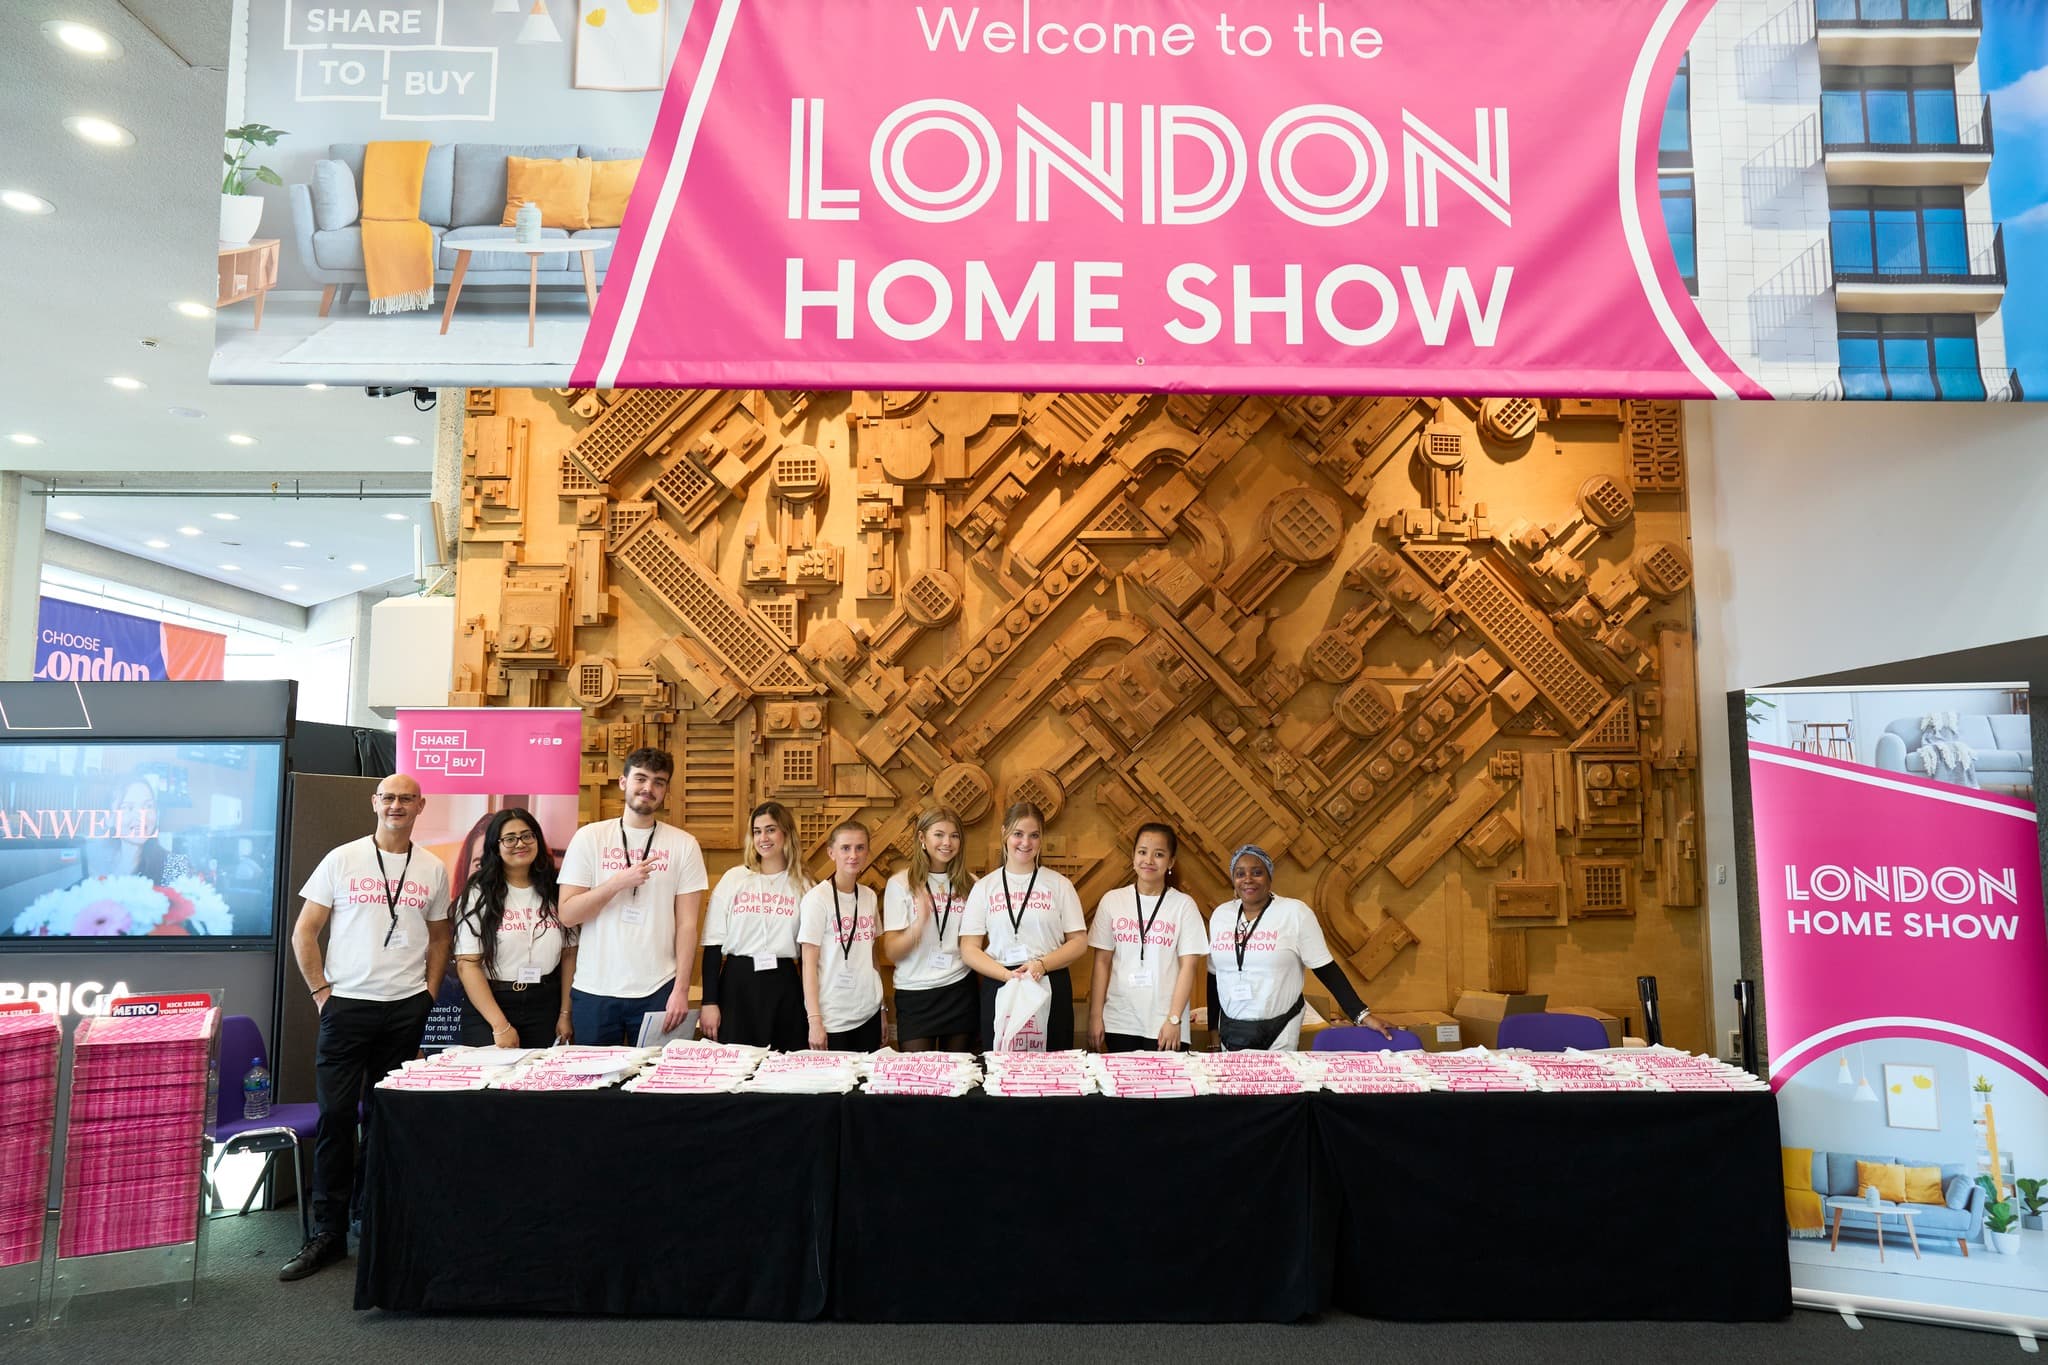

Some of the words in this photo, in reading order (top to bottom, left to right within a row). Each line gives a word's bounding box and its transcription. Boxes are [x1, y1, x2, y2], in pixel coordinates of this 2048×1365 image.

[306, 8, 422, 34] SHARE
[916, 0, 1195, 57] Welcome
[1216, 13, 1273, 58] to
[1294, 2, 1384, 60] the
[320, 60, 366, 86] TO
[404, 71, 475, 96] BUY
[788, 97, 1513, 228] LONDON
[784, 257, 1124, 342] HOME
[1164, 262, 1515, 347] SHOW
[42, 629, 101, 652] CHOOSE
[420, 735, 460, 746] SHARE
[424, 754, 441, 764] TO
[452, 757, 477, 767] BUY
[602, 862, 632, 872] HOM
[1784, 865, 2018, 905] LONDON
[349, 894, 388, 905] HOME
[392, 896, 427, 910] HOW
[1025, 902, 1051, 911] HOW
[734, 905, 761, 916] HOME
[1111, 917, 1176, 935] LONON
[1788, 910, 1893, 937] HOME
[1903, 911, 2020, 941] SHOW
[1142, 935, 1174, 948] SHOW
[1216, 930, 1278, 941] LOON
[1212, 943, 1235, 951] HOM
[113, 1004, 158, 1017] METRO
[425, 1023, 436, 1031] for
[1015, 1038, 1024, 1047] TO
